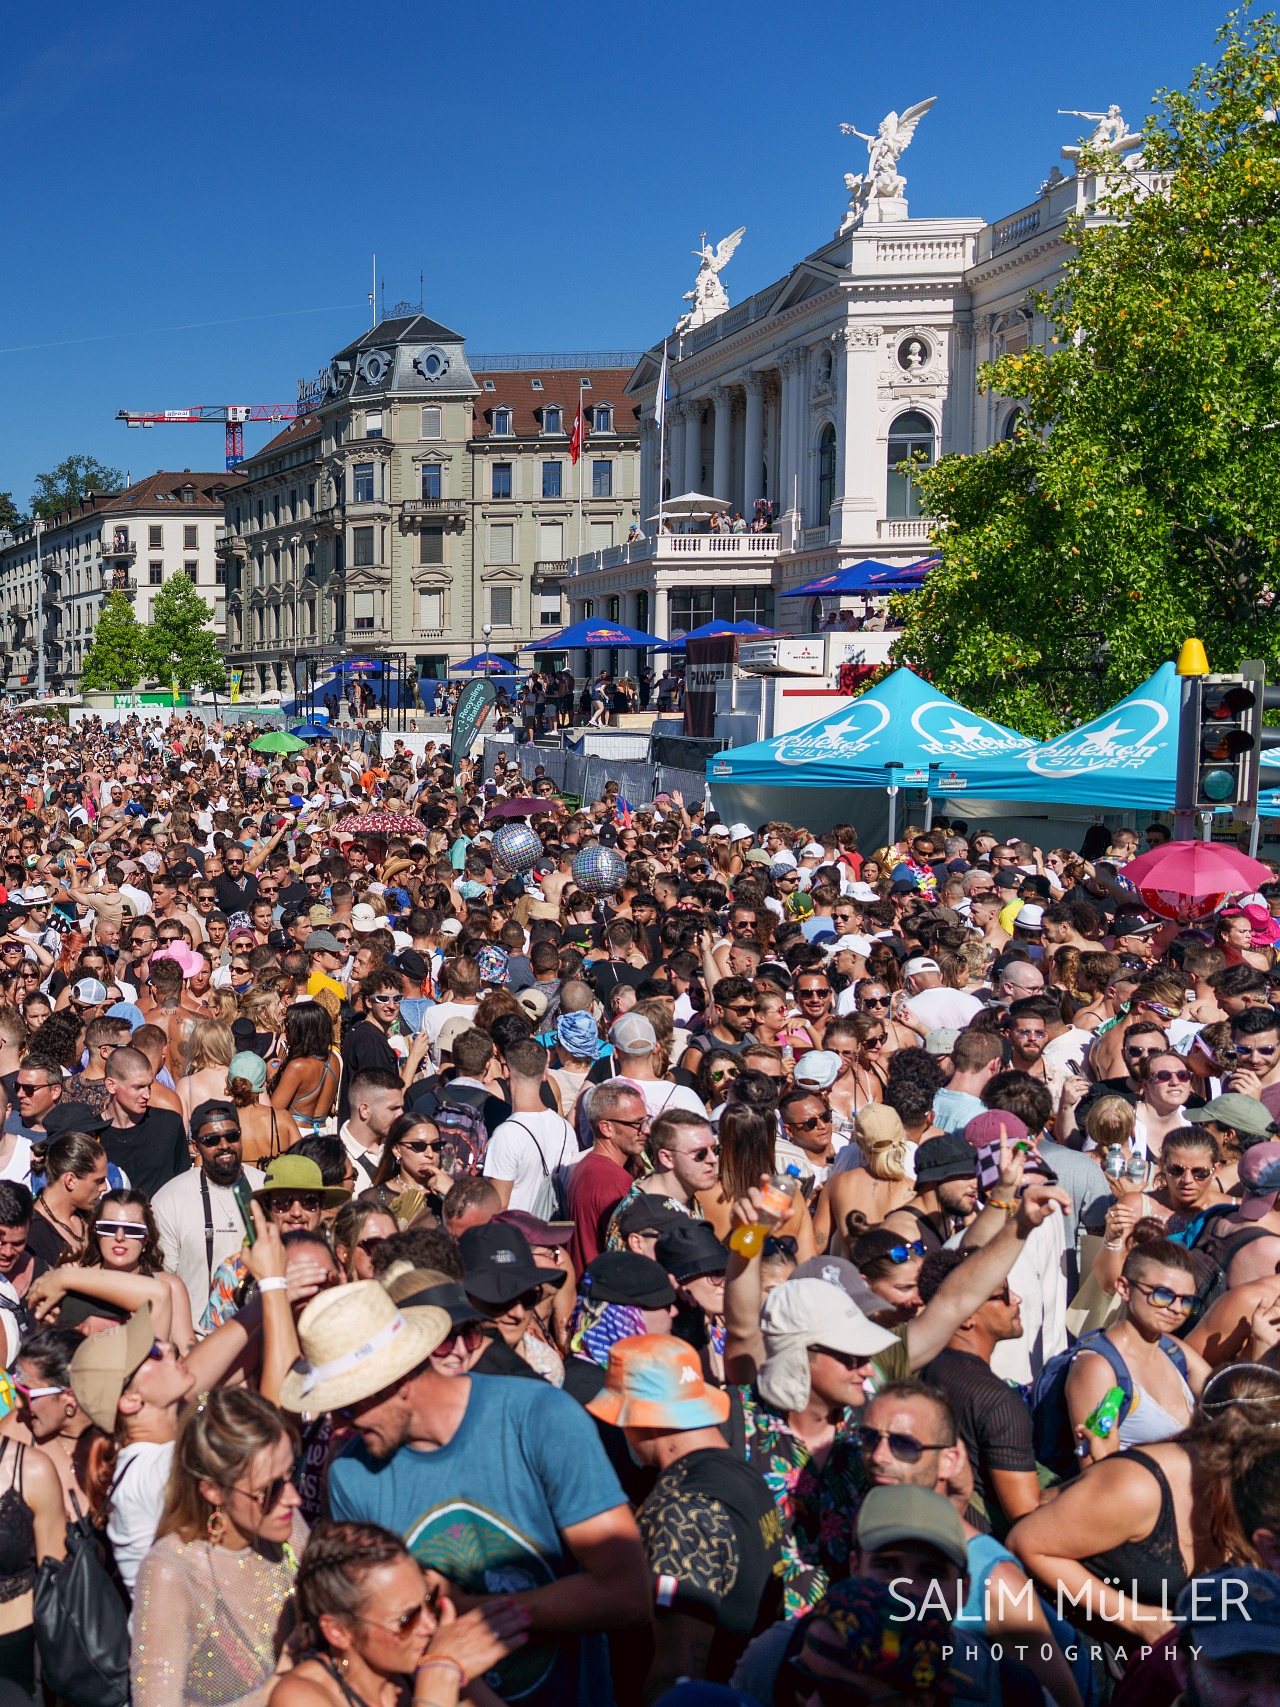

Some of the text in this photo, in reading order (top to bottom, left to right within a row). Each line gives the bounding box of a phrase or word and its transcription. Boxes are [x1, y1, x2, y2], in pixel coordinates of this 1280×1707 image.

[585, 635, 605, 643] Red
[459, 683, 484, 719] Recycling
[467, 696, 486, 723] Station
[768, 735, 873, 752] Heineken
[917, 736, 1042, 755] Heineken
[1013, 741, 1162, 759] Heineken
[787, 748, 858, 759] SILVER
[1045, 756, 1146, 769] SILVER
[940, 779, 966, 787] Heineken
